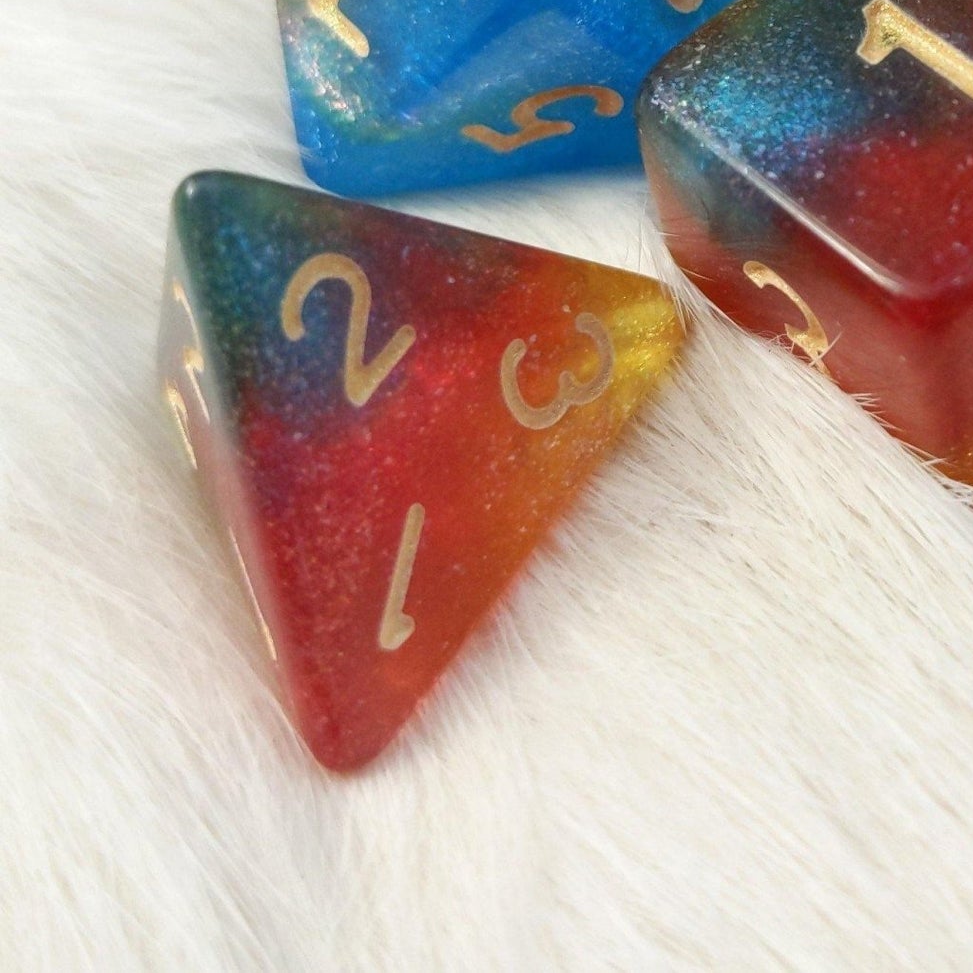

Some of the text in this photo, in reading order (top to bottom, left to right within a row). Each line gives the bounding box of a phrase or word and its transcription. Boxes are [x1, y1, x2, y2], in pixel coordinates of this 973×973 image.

[461, 85, 624, 154] 5
[282, 253, 416, 407] 2
[501, 312, 615, 429] 3
[379, 503, 425, 650] 1
